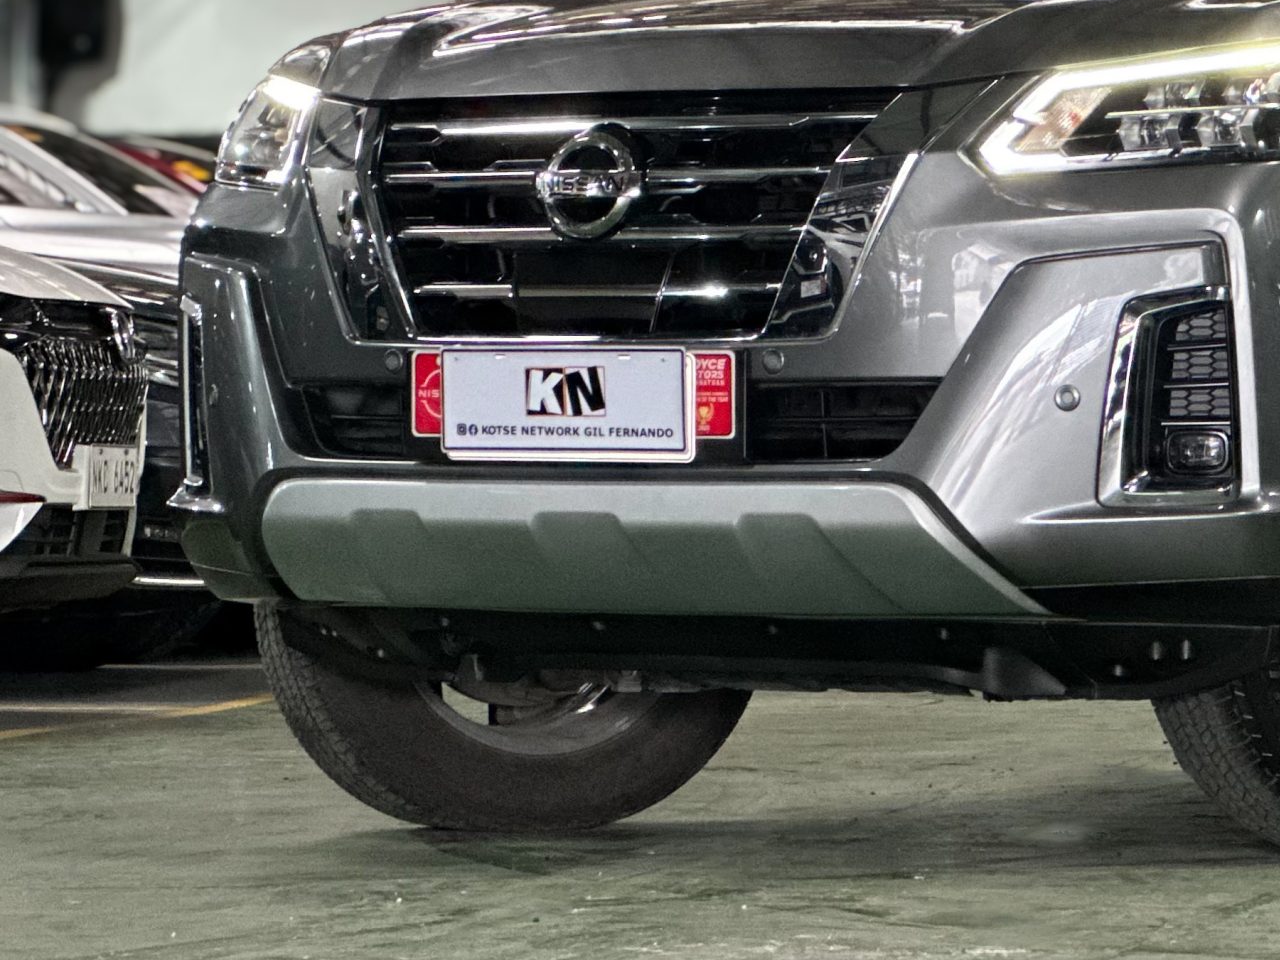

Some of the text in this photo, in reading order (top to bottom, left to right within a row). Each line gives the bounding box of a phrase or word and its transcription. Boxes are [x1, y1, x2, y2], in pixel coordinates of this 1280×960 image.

[541, 175, 625, 193] NISSAN
[529, 366, 605, 416] KN
[482, 425, 674, 438] KOTSE NETWORK GIL FERNANDO
[113, 460, 135, 493] 6452
